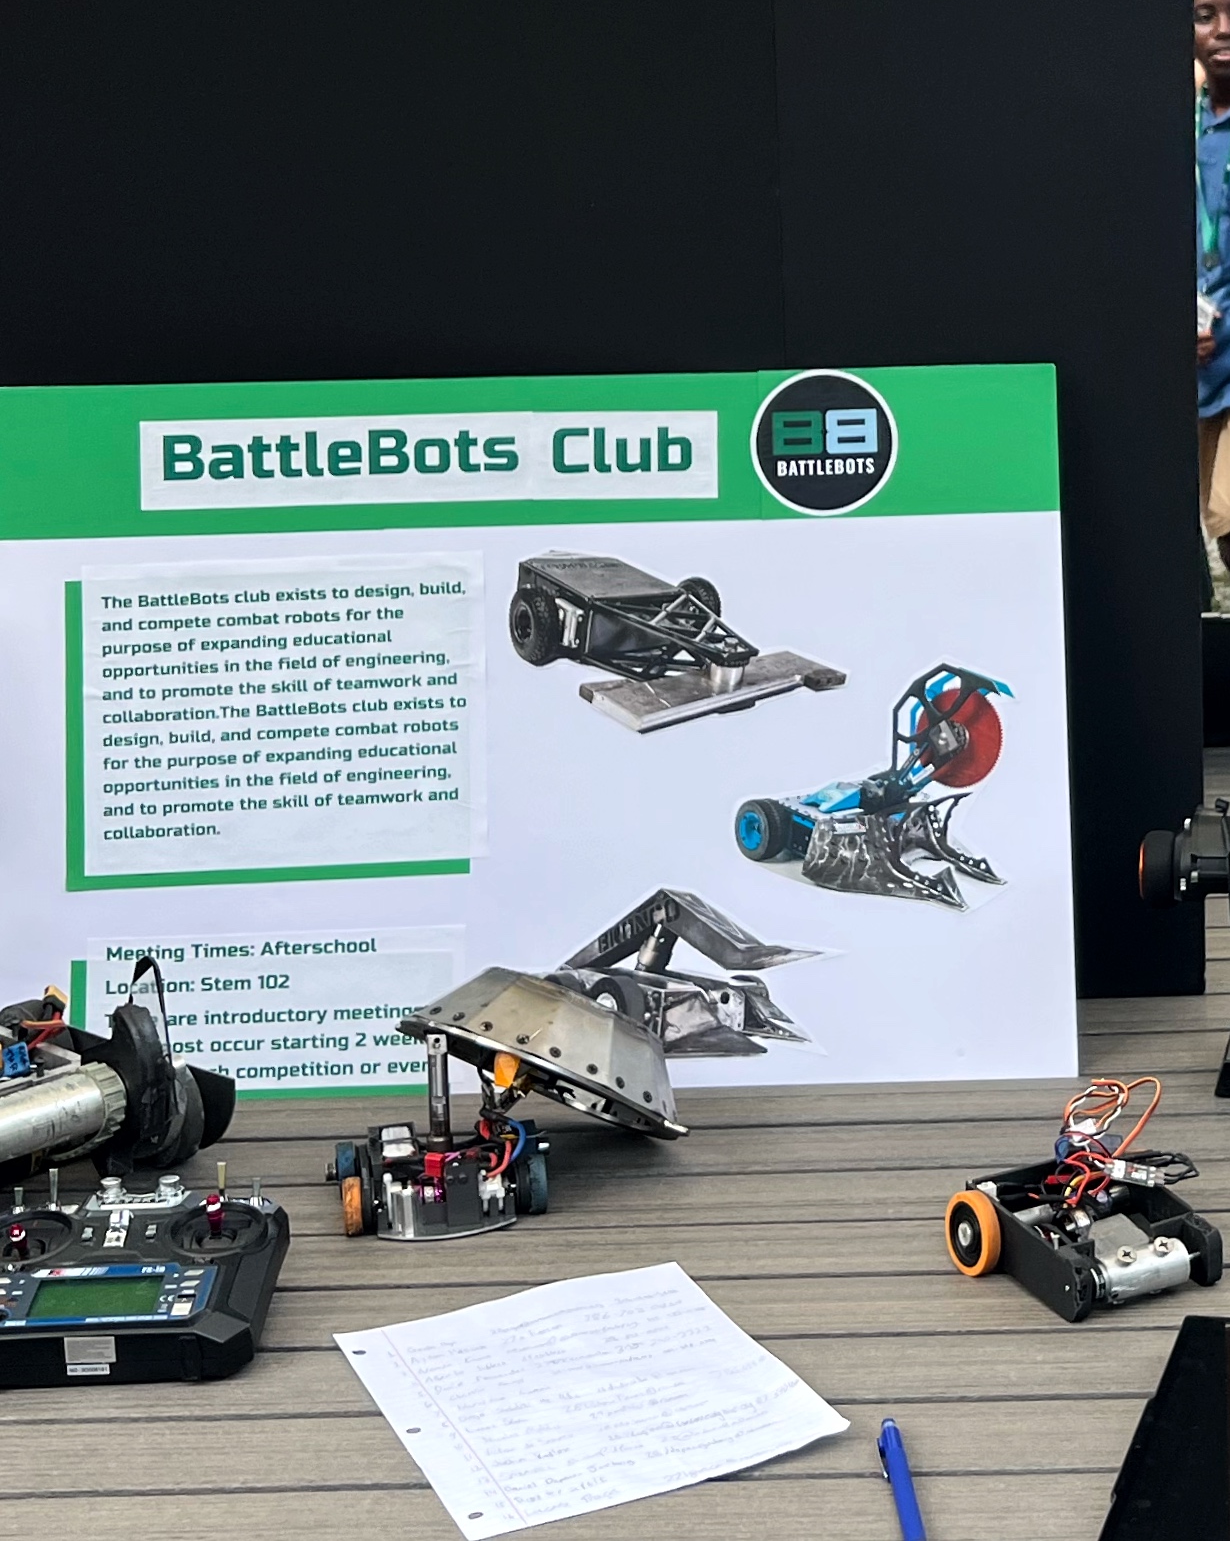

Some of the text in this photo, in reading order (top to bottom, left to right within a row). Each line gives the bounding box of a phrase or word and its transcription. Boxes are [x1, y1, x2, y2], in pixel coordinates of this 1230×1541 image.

[162, 427, 693, 481] BattleBots Club
[777, 457, 875, 477] BATTLEBOTS
[100, 595, 133, 610] The
[137, 592, 230, 608] BattleBots
[233, 589, 271, 604] club
[275, 587, 327, 602] exists
[330, 586, 350, 600] to
[100, 606, 404, 633] and compete combat robots for the
[101, 629, 393, 659] purpose of expanding educational
[101, 660, 220, 681] opportunities
[223, 659, 240, 673] in
[244, 658, 273, 673] the
[277, 655, 318, 671] field
[321, 654, 342, 669] of
[101, 671, 458, 702] and to promote the skill of teamwork and
[255, 701, 348, 718] BattleBots
[351, 698, 389, 713] club
[392, 696, 445, 711] exists
[449, 695, 467, 709] to
[219, 727, 252, 742] and
[256, 724, 330, 742] compete
[334, 721, 399, 737] combat
[403, 719, 460, 734] robots
[102, 740, 458, 771] for the purpose of expanding educational
[102, 775, 220, 797] opportunities
[224, 774, 242, 788] in
[245, 773, 275, 788] the
[278, 769, 319, 786] field
[322, 769, 343, 784] of
[102, 787, 459, 818] and to promote the skill of teamwork and
[106, 937, 377, 963] Meeting Times: Afterschool
[200, 975, 252, 993] Stem
[258, 974, 290, 990] 102
[167, 1012, 198, 1027] are
[204, 1006, 327, 1026] introductory
[210, 1038, 265, 1053] occur
[271, 1033, 350, 1051] starting
[355, 1032, 367, 1047] 2
[236, 1060, 354, 1082] competition
[360, 1061, 382, 1075] or
